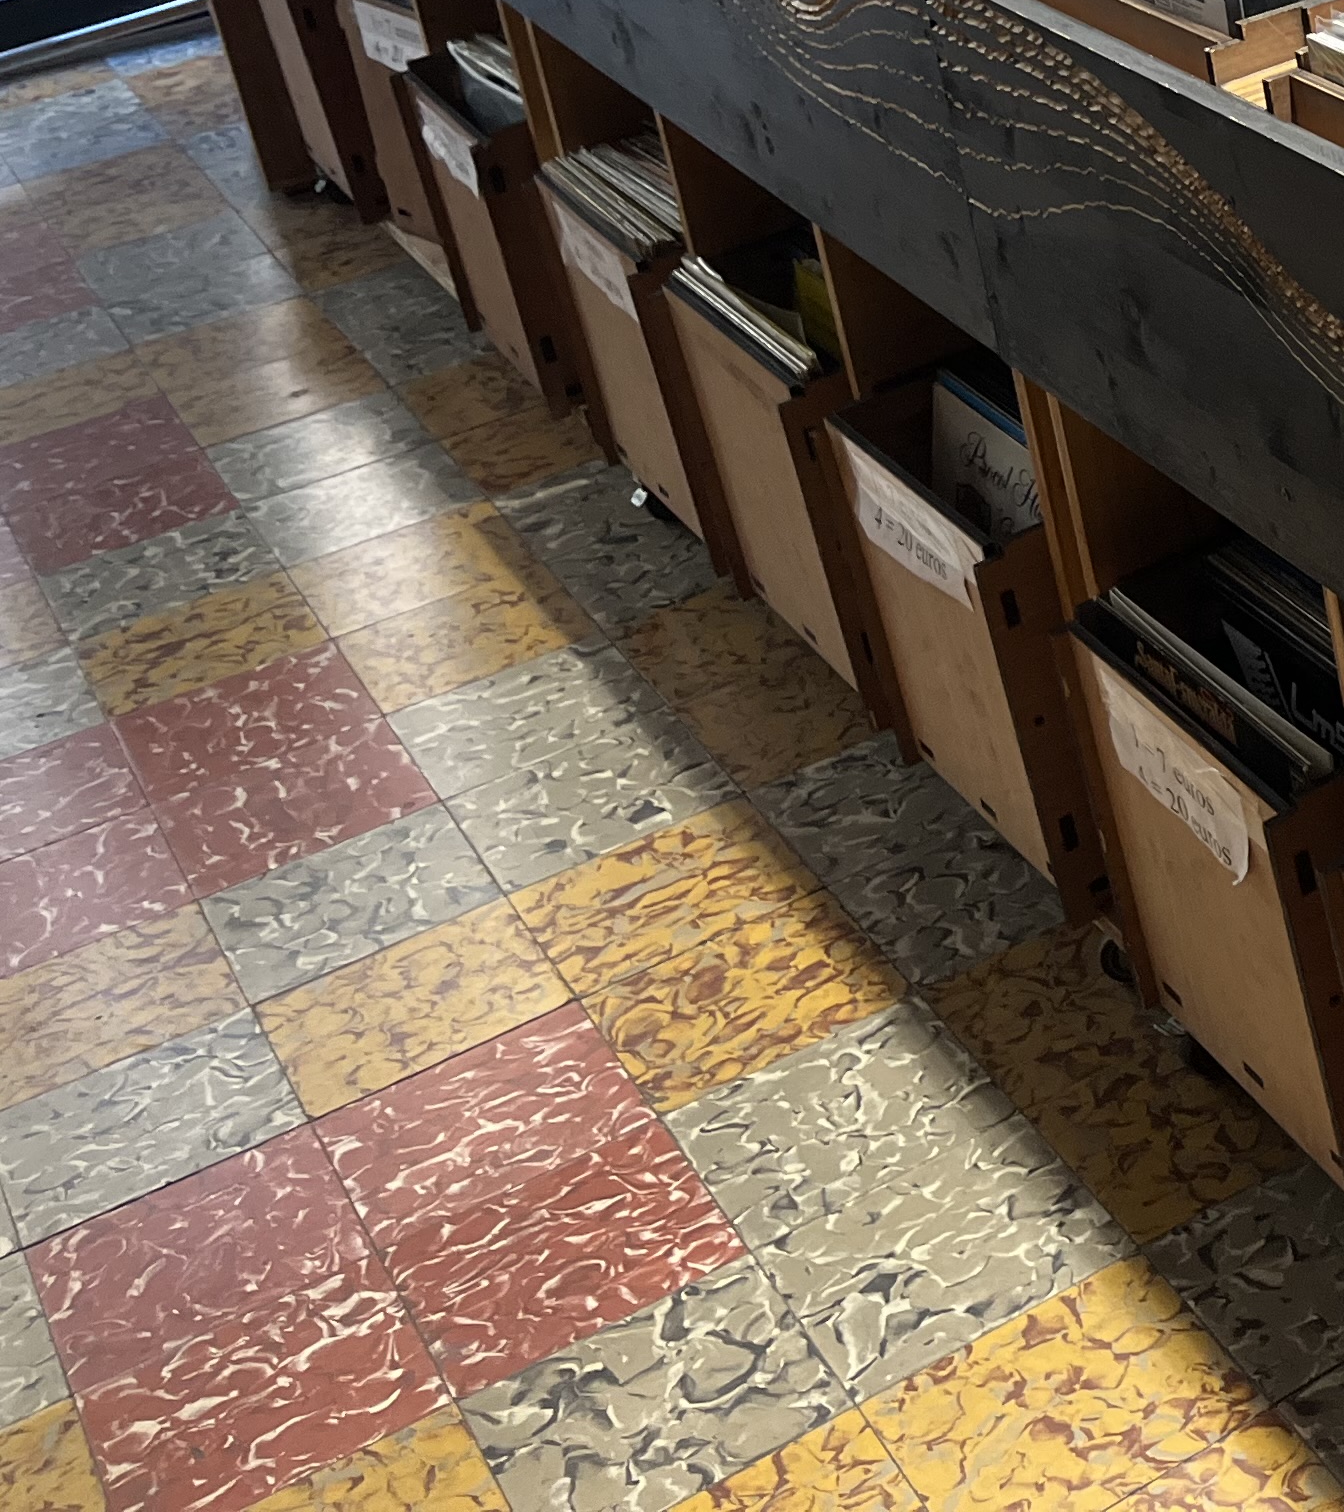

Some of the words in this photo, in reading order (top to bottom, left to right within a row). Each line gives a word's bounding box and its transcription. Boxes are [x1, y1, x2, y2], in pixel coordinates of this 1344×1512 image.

[897, 521, 914, 552] 20
[915, 546, 948, 581] euros
[1173, 766, 1216, 816] euros
[1166, 786, 1190, 822] 20
[1190, 814, 1232, 867] euros
